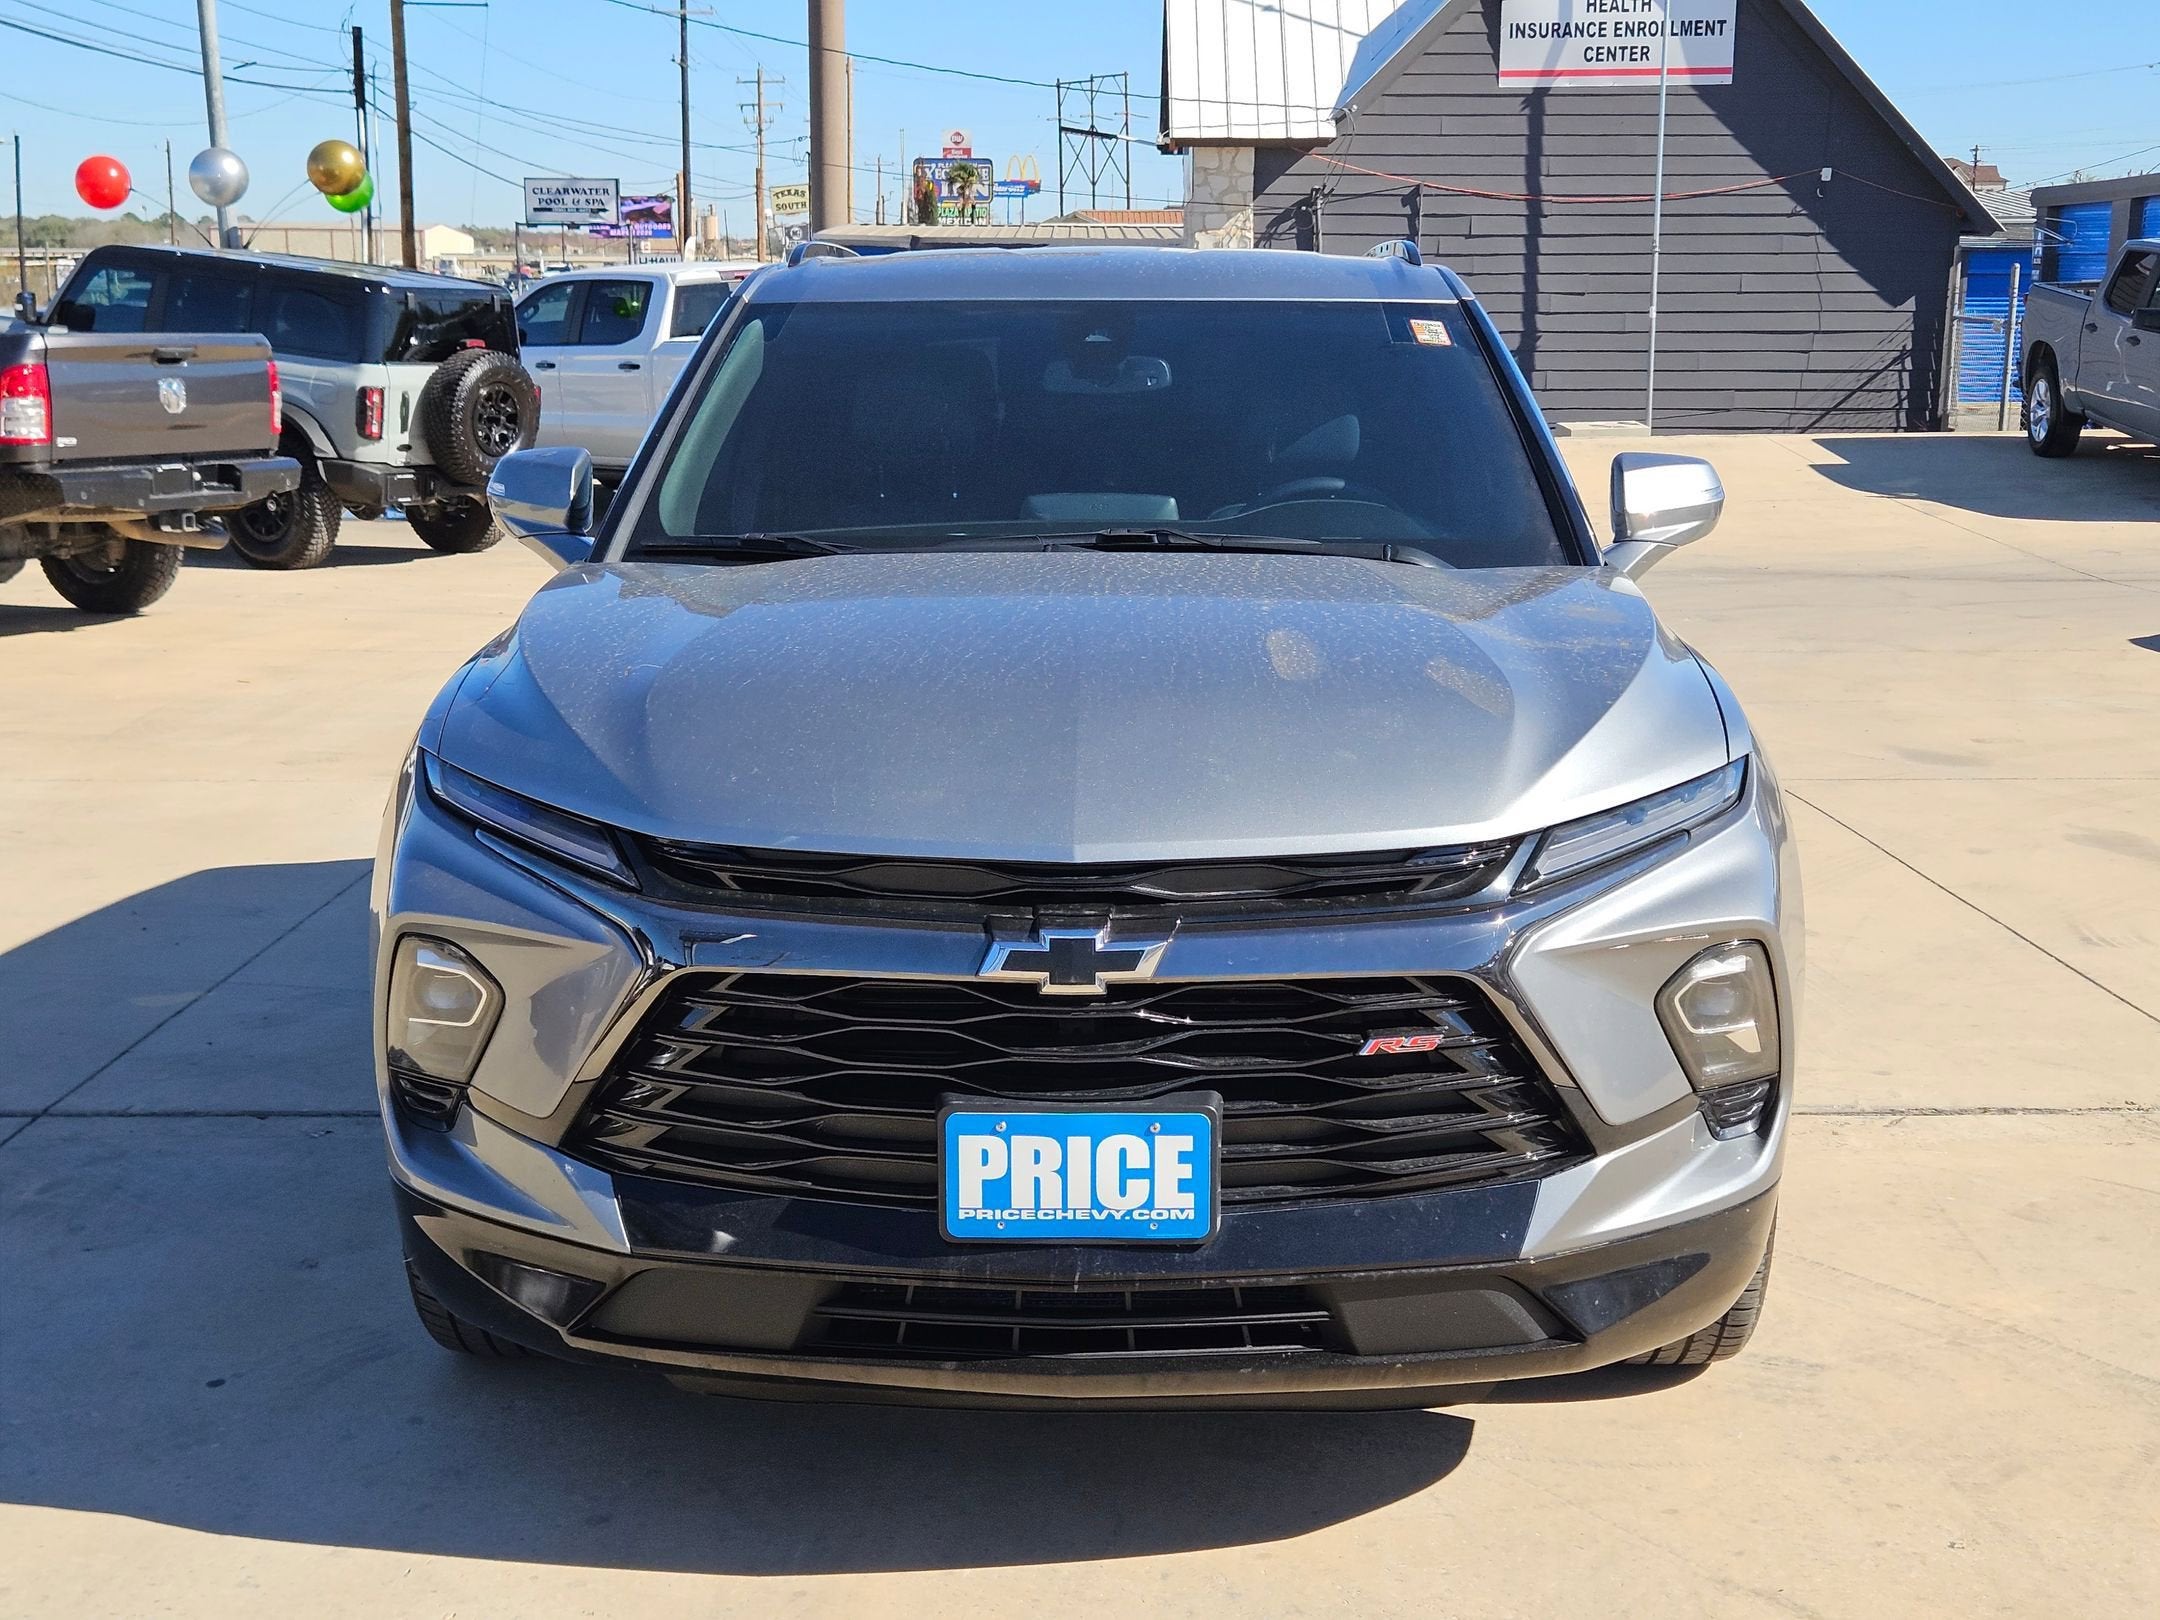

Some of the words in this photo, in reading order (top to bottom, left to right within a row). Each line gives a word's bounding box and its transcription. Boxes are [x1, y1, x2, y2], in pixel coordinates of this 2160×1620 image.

[1586, 0, 1652, 13] HEALTH
[1509, 21, 1608, 38] INSURANCE
[1583, 46, 1651, 63] CENTER
[532, 187, 610, 196] CLEARWATER
[772, 188, 807, 200] TEXAS
[538, 197, 568, 206] POOL
[571, 197, 580, 206] &
[585, 197, 605, 206] SPA
[775, 201, 807, 212] SOUTH
[1359, 1034, 1445, 1056] RS
[958, 1134, 1195, 1210] PRICE
[958, 1208, 1195, 1220] PRICECHEVY.COM
